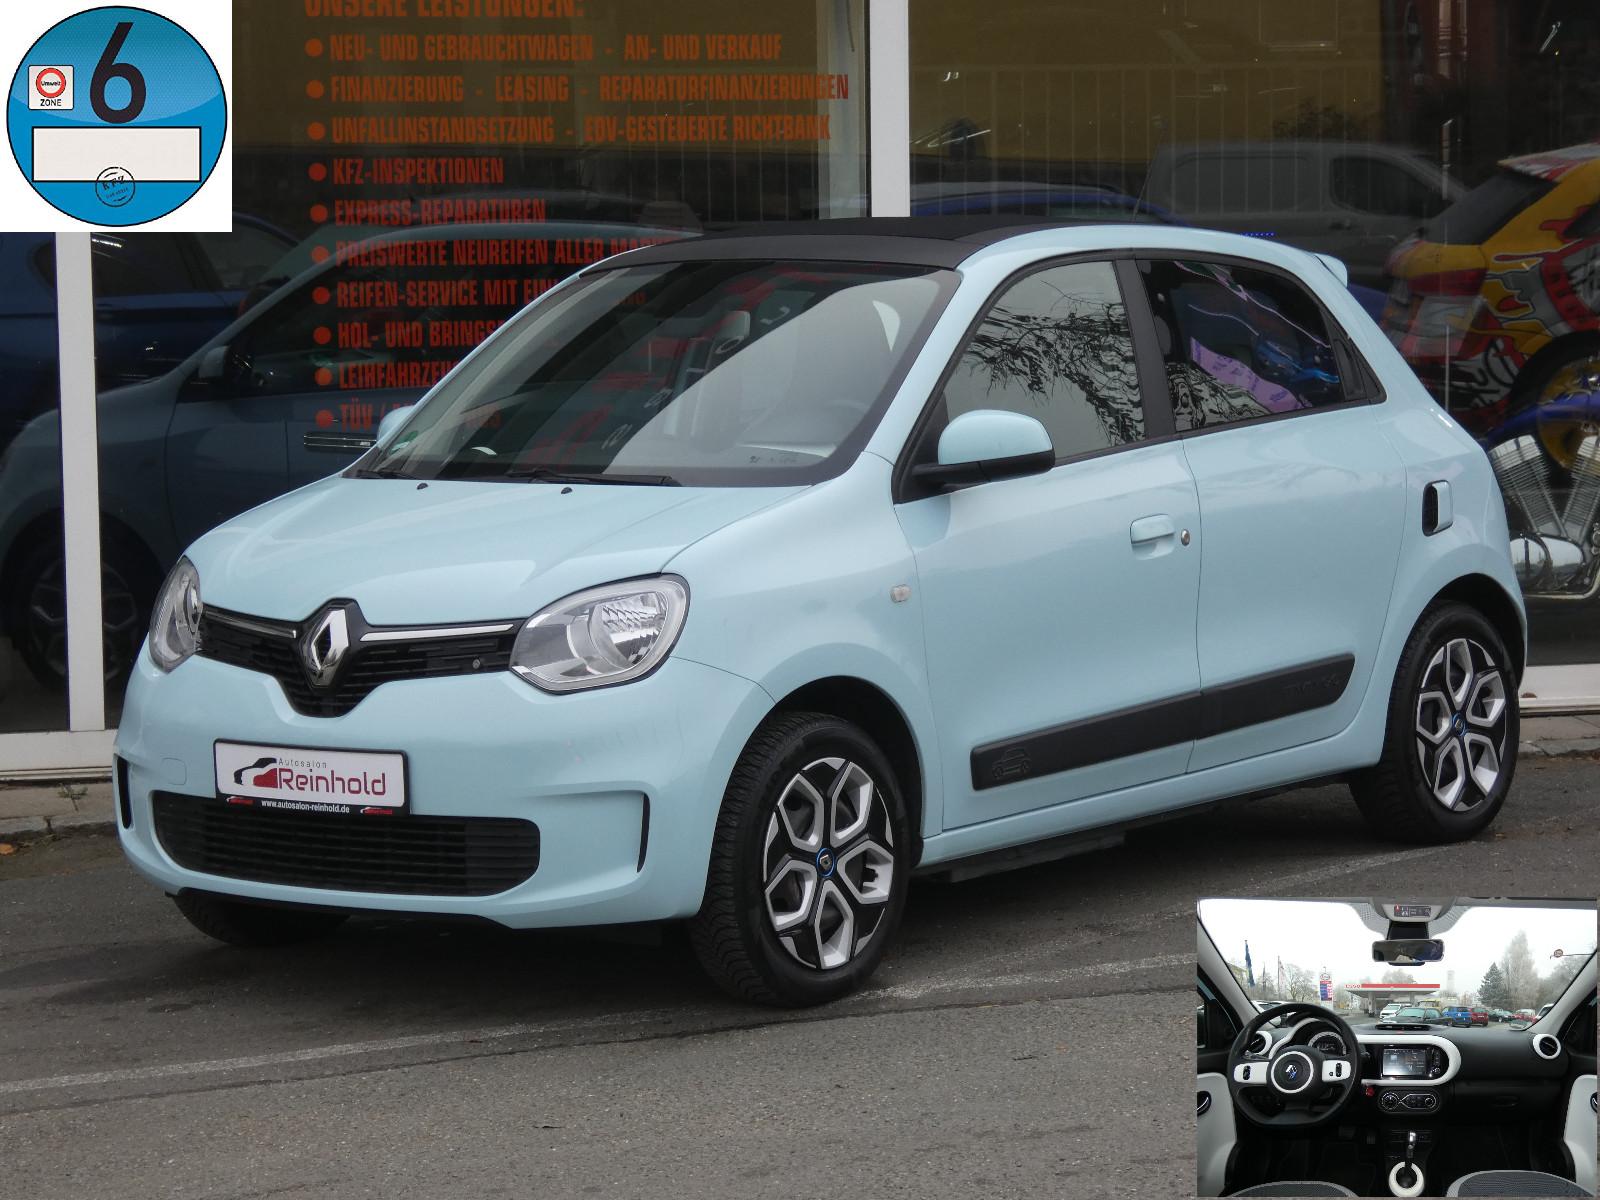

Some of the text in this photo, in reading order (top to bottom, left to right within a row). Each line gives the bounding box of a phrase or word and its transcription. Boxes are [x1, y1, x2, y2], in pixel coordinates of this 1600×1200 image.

[329, 34, 374, 61] NEU-
[380, 34, 418, 61] UND
[424, 34, 593, 61] GEBRAUCHTWAGEN
[624, 34, 657, 61] AN-
[663, 34, 700, 60] UND
[706, 34, 782, 60] VERKAUF
[331, 75, 464, 102] FINANZIERUNG
[495, 75, 569, 102] LEASING
[601, 74, 849, 101] REPARATURFINANZIERUNGEN
[331, 116, 555, 144] UNFALLINSTANDSETZUNG
[583, 114, 727, 142] EDV-GESTEUERTE
[733, 114, 831, 141] RICHTBANK
[333, 157, 505, 185] KFZ-INSPEKTIONEN
[334, 198, 547, 225] EXPRESS-REPARATUREN
[335, 239, 447, 267] PREISWERTE
[453, 238, 548, 266] NEUREIFEN
[554, 237, 604, 264] ALLER
[337, 279, 478, 308] REIFEN-SERVICE
[484, 279, 518, 305] MIT
[338, 322, 378, 349] HOL-
[385, 321, 423, 348] UND
[340, 359, 461, 389] LEIHFAHRZEU
[340, 398, 373, 432] TÜV
[278, 757, 327, 769] Autosalon
[279, 767, 387, 797] Reinhold
[261, 799, 350, 814] www.autosalon-reinhold.de
